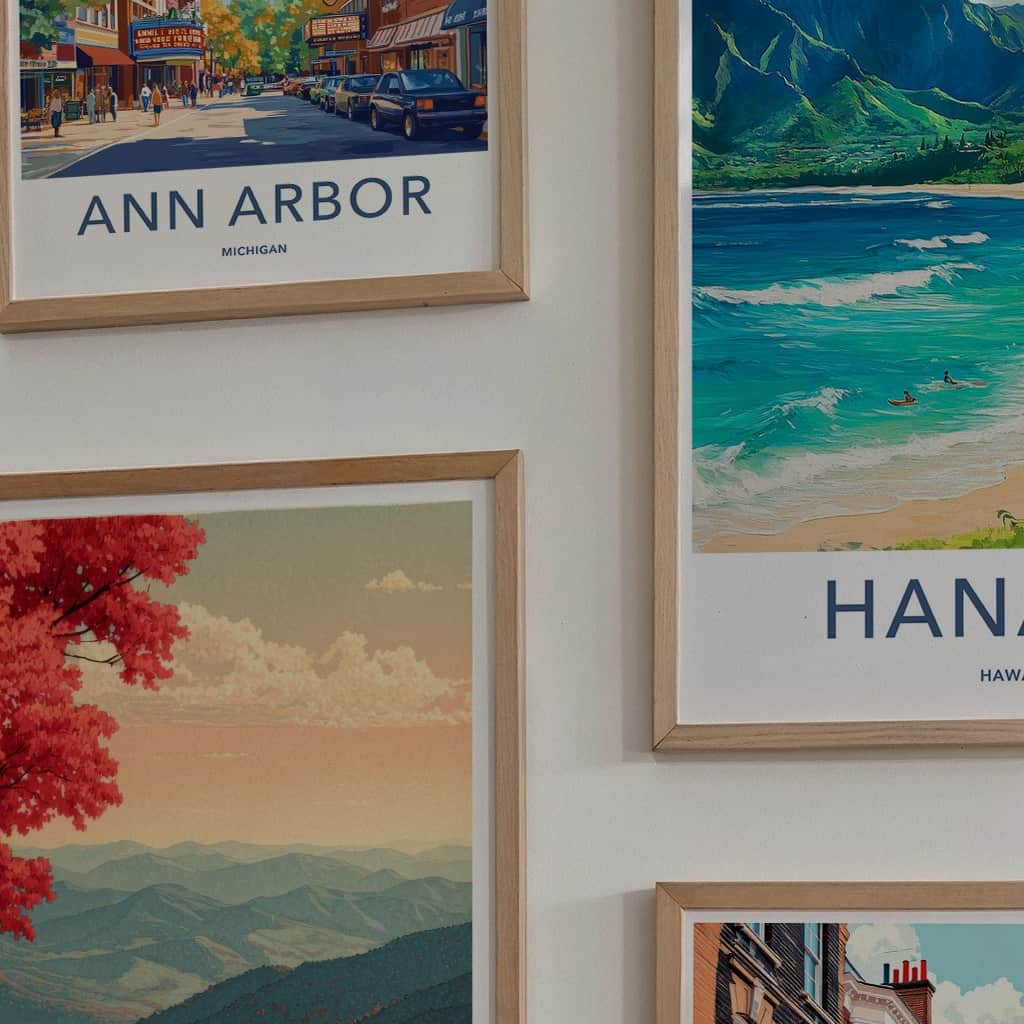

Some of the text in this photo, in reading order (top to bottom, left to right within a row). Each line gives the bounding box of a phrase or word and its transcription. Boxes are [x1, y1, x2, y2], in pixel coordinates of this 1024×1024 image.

[77, 175, 432, 236] ANN ARBOR
[222, 244, 287, 257] MICHIGAN
[827, 577, 1024, 640] HAN
[980, 668, 1024, 682] HAW
